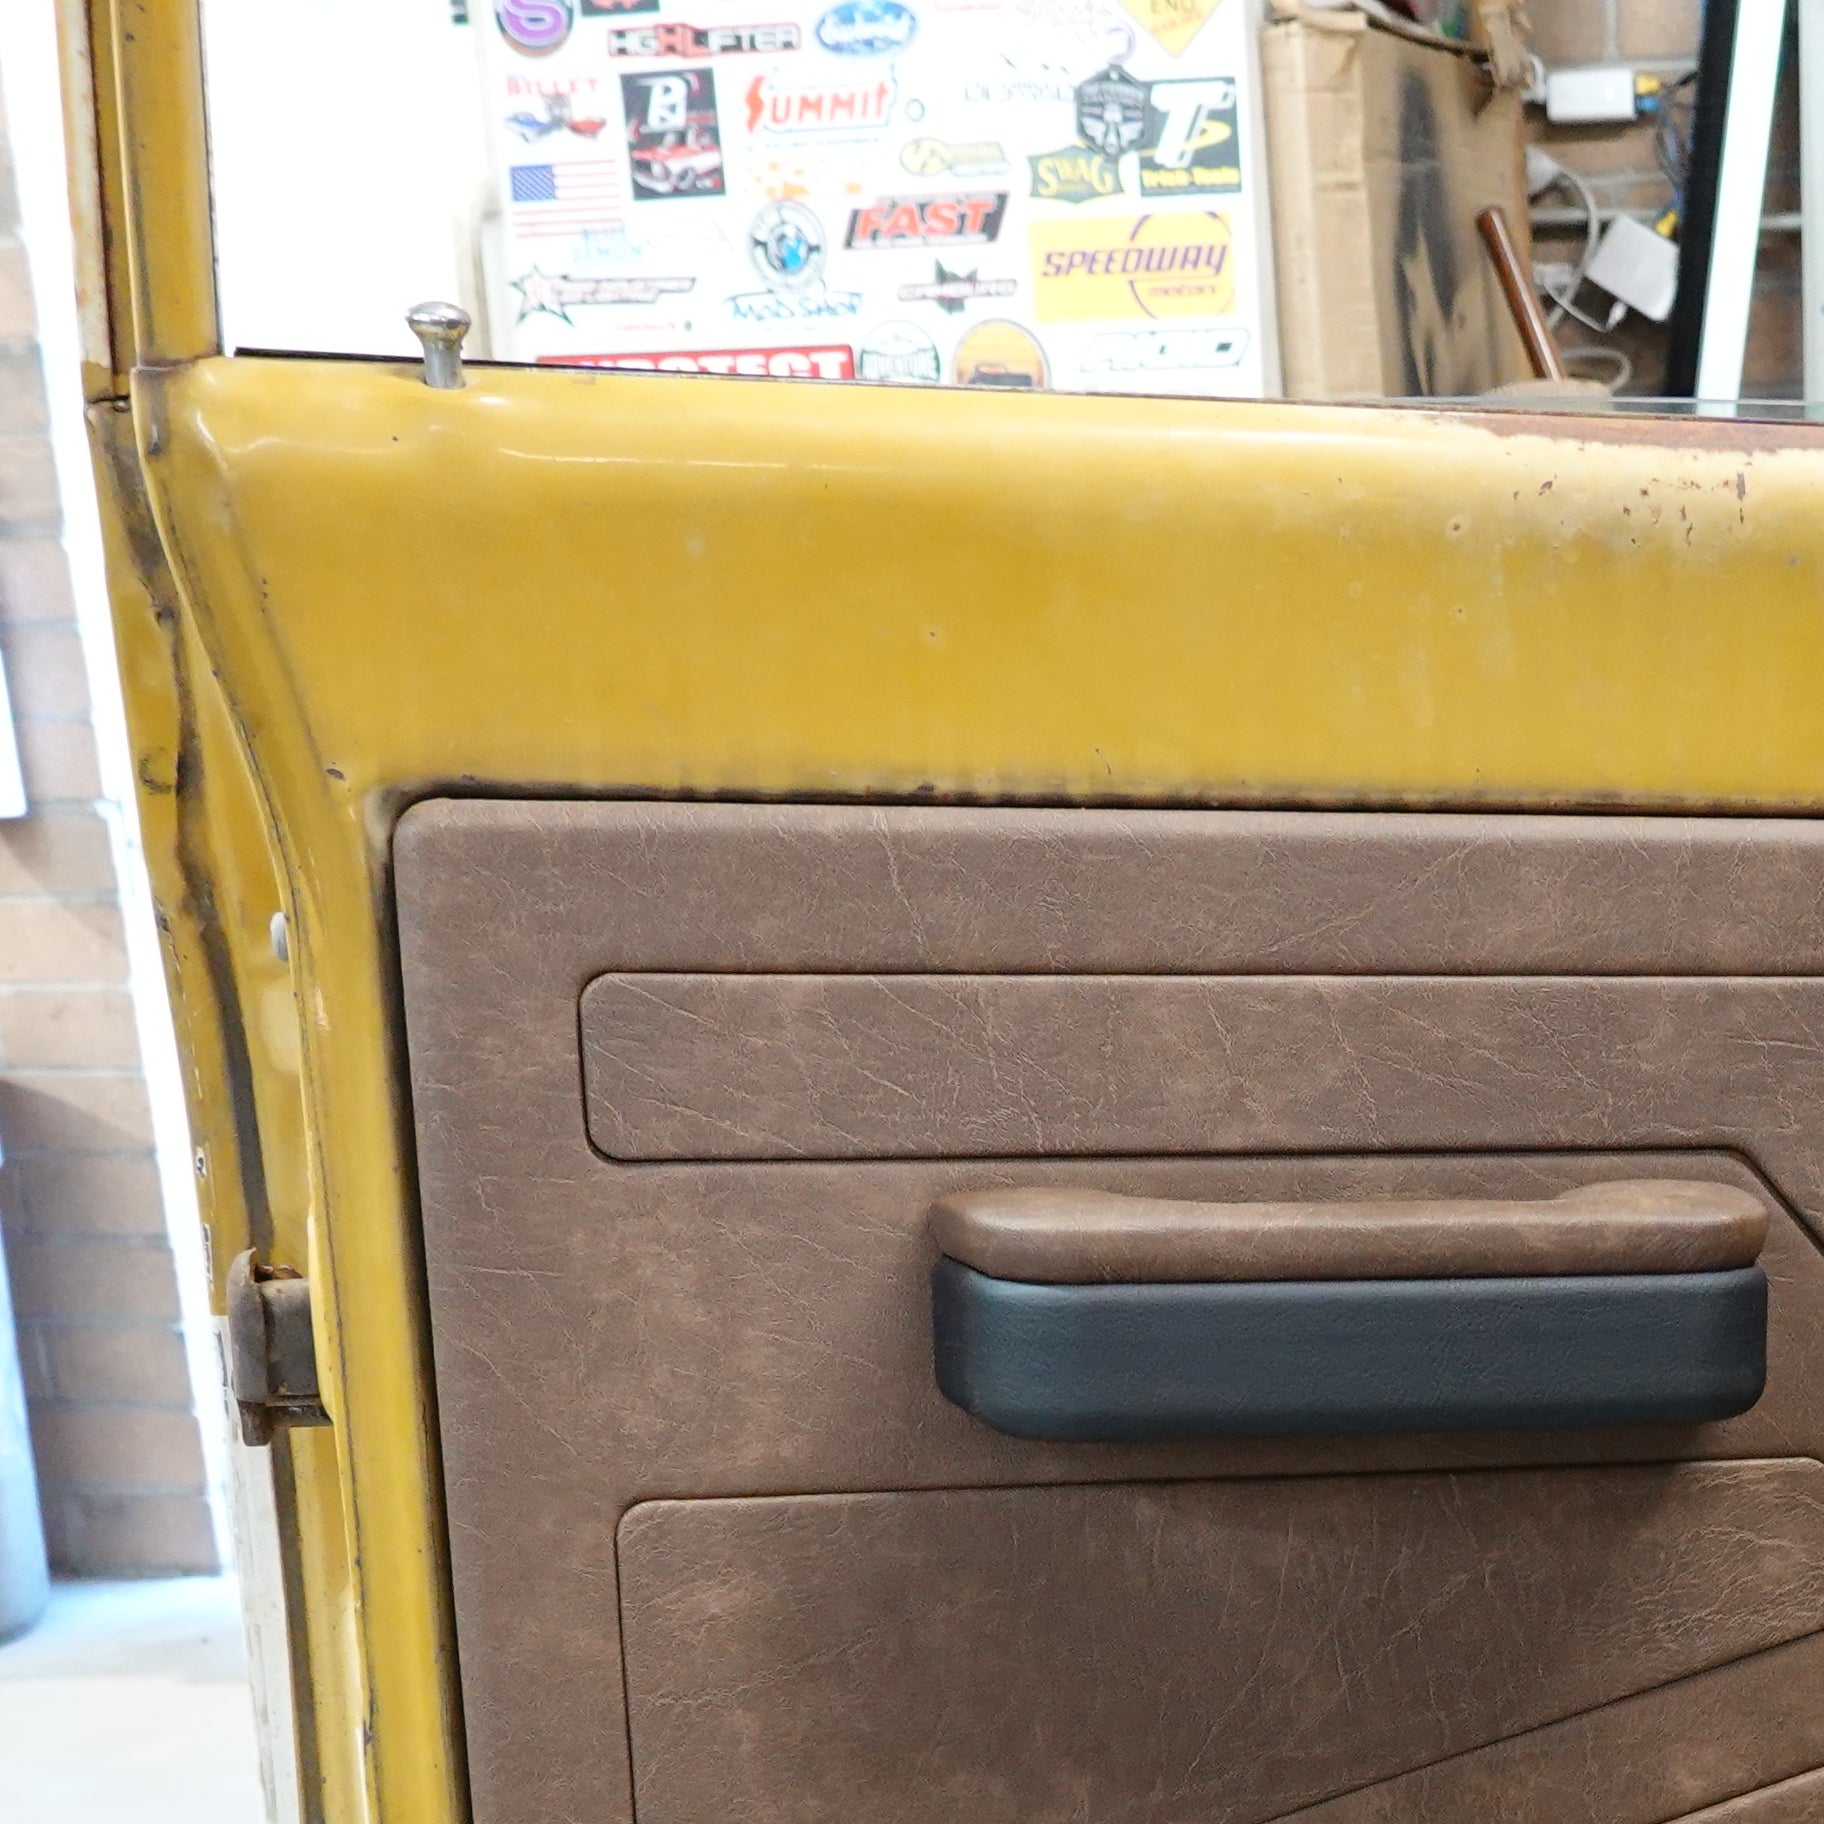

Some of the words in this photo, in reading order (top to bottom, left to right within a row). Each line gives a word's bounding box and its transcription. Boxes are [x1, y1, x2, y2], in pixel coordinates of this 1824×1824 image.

[745, 77, 889, 133] SUMMIT
[857, 200, 993, 238] FAST
[1042, 244, 1227, 277] SPEEDWAY
